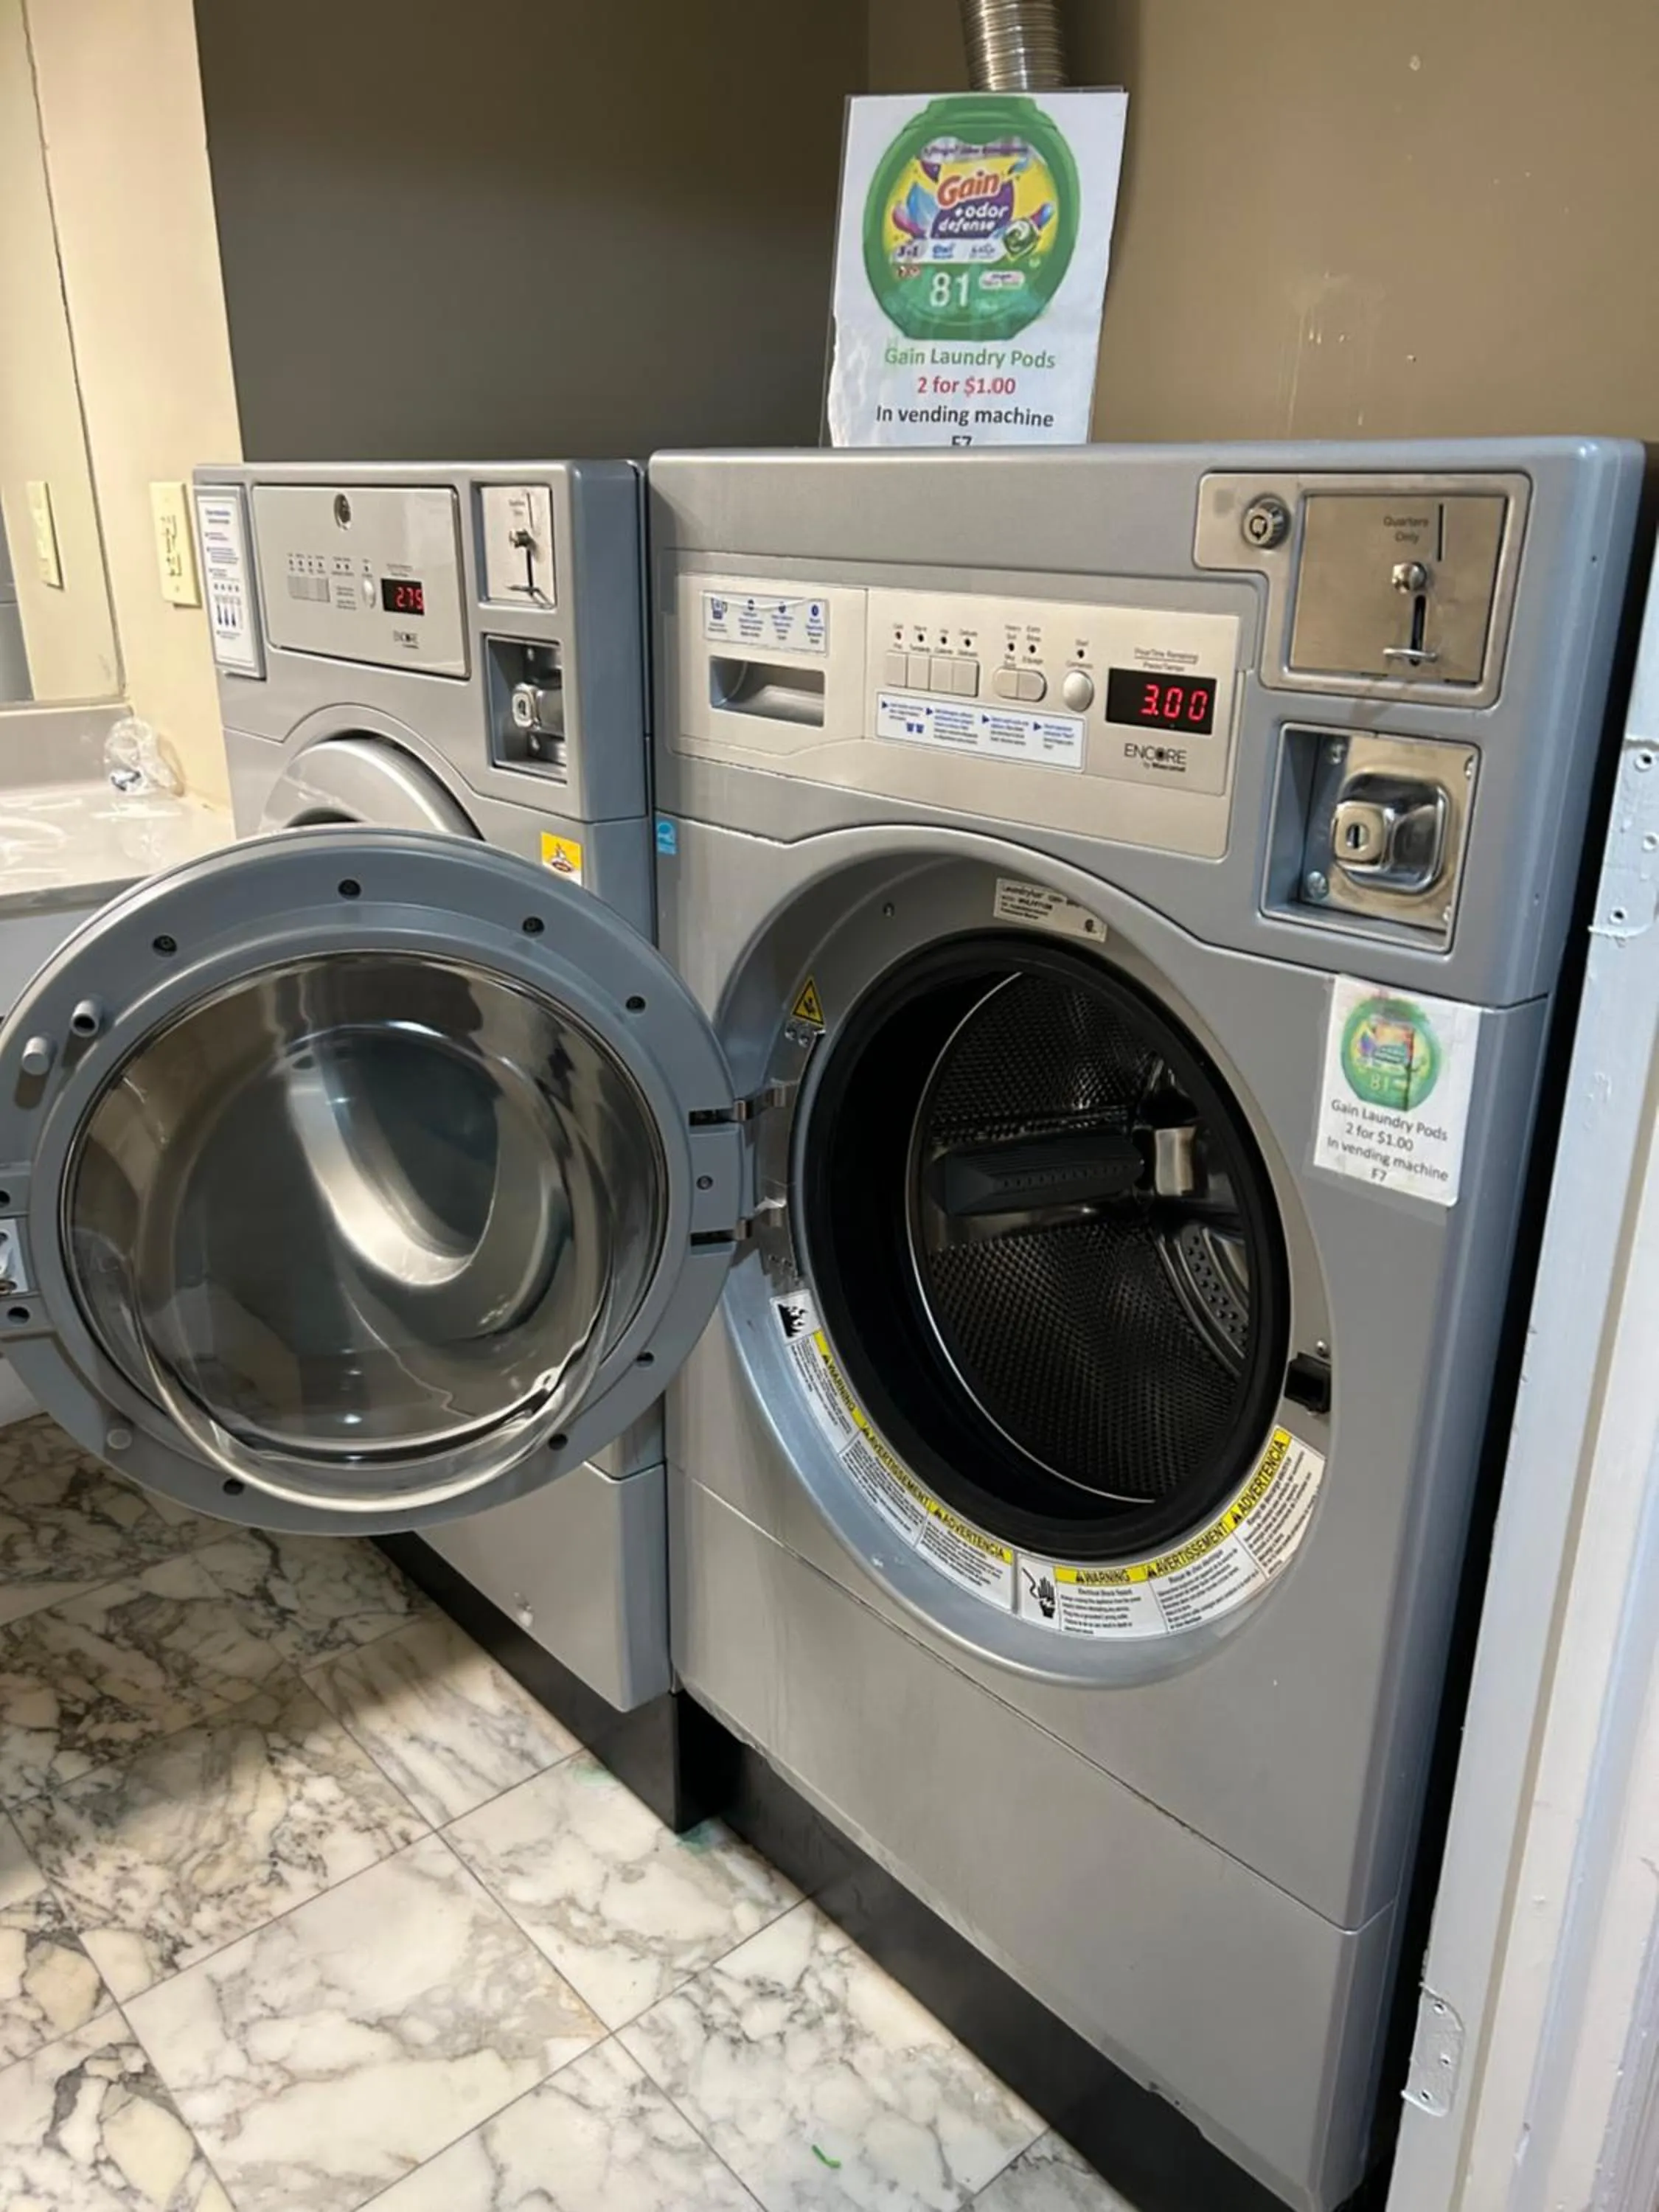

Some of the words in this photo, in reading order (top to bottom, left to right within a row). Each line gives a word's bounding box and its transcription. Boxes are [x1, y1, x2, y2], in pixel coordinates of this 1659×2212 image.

[938, 171, 1000, 206] Gain
[938, 219, 995, 233] defense
[930, 272, 969, 307] 81
[885, 348, 925, 365] Gain
[931, 349, 1005, 369] Laundry
[1011, 350, 1056, 369] Pods
[917, 378, 928, 394] 2
[933, 376, 959, 394] for
[964, 376, 1016, 397] $1.00
[876, 406, 892, 422] In
[898, 406, 970, 426] vending
[975, 407, 1054, 427] machine
[1383, 516, 1429, 529] Quarters
[1395, 532, 1419, 545] Only
[1141, 684, 1208, 721] 3.00
[1124, 742, 1187, 765] ENCORE
[1331, 1099, 1359, 1116] Gain
[1362, 1107, 1413, 1133] Laundry
[1416, 1122, 1448, 1141] Pods
[1345, 1122, 1354, 1135] 2
[1356, 1124, 1374, 1141] for
[1377, 1133, 1414, 1152] $1.00
[1328, 1135, 1340, 1150] In
[1342, 1140, 1391, 1167] vending
[1393, 1157, 1448, 1182] machine
[1371, 1169, 1388, 1182] F7
[1237, 1440, 1284, 1515] ADVERTENCIA
[1156, 1522, 1231, 1573] AVERTISSEMENT
[1085, 1570, 1130, 1584] WARNING
